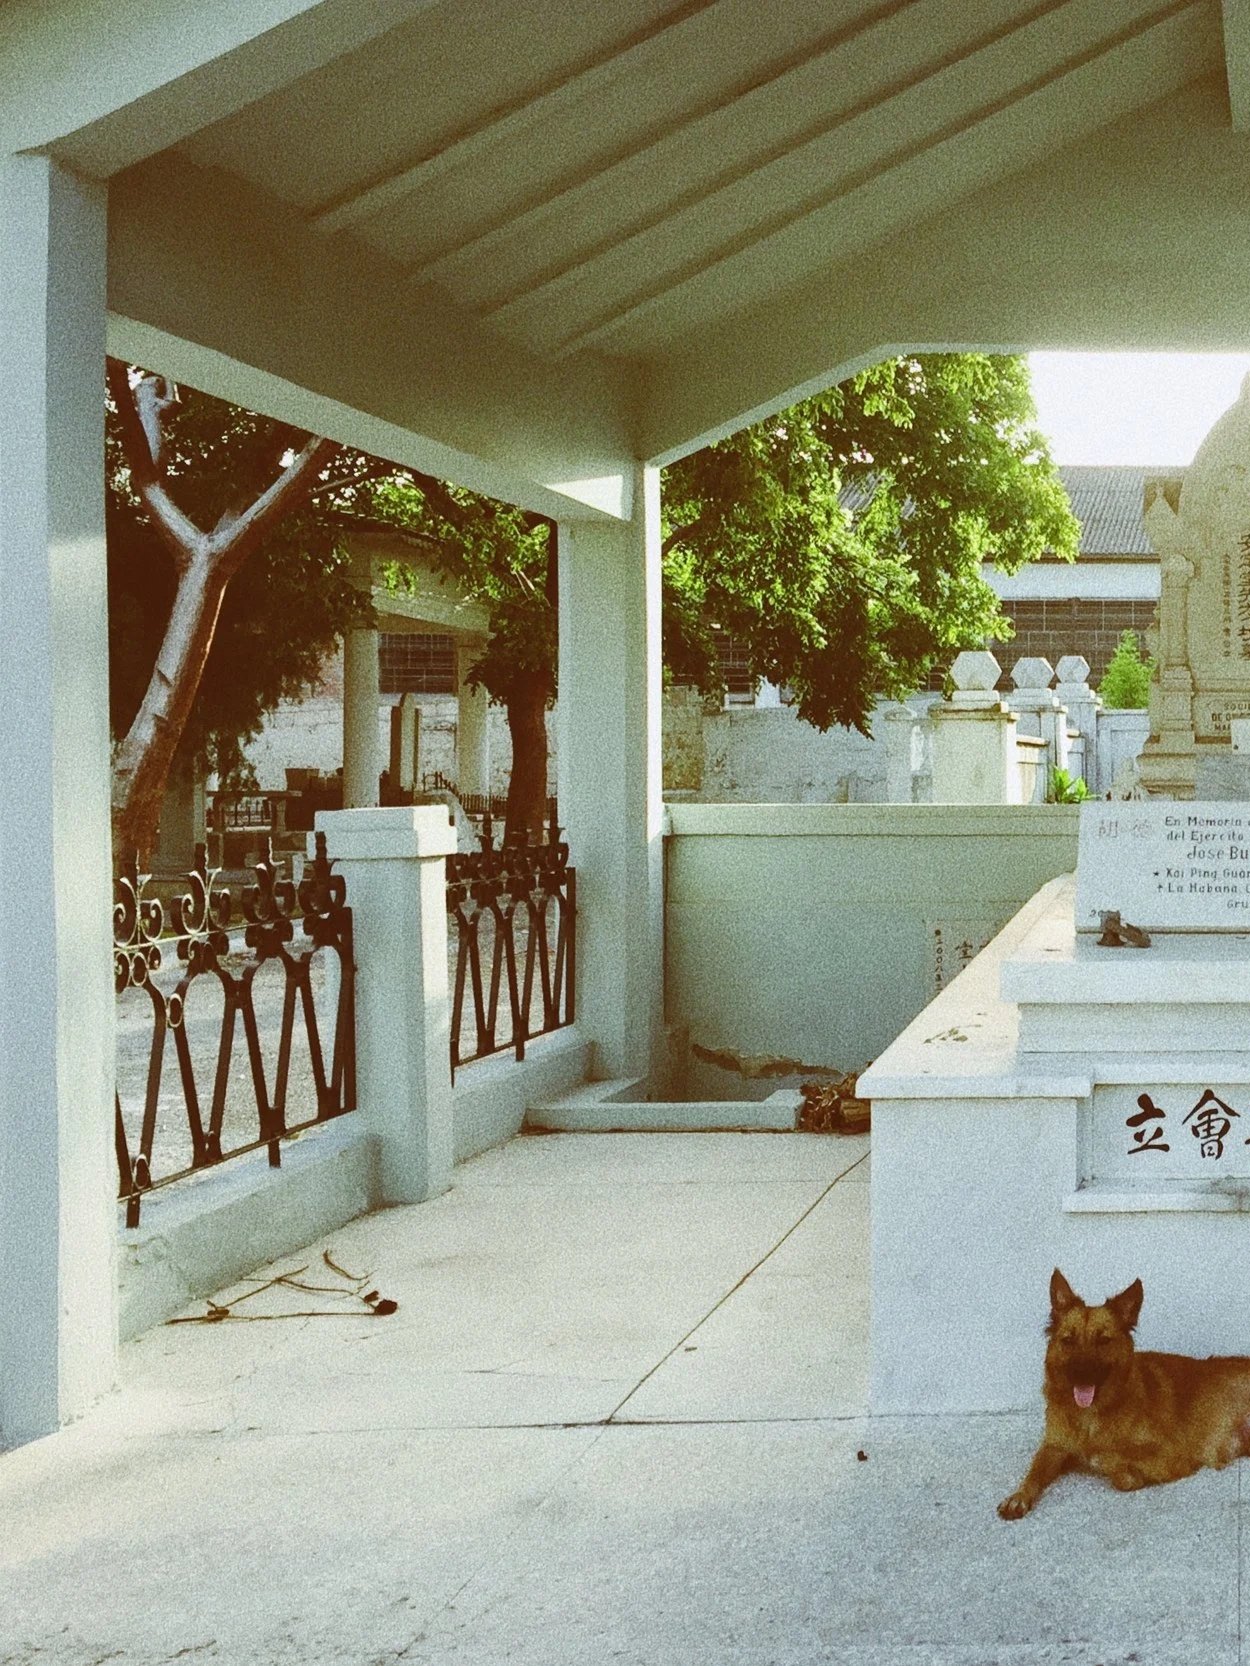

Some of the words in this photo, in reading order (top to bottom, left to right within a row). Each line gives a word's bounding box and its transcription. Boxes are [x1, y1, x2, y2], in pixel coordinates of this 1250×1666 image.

[1165, 816, 1181, 827] En
[1187, 816, 1243, 827] Memoria
[1166, 830, 1186, 841] del
[1190, 831, 1245, 844] Ejercito
[1229, 846, 1249, 860] Bu
[1190, 868, 1218, 881] Ping
[1168, 882, 1184, 894] La
